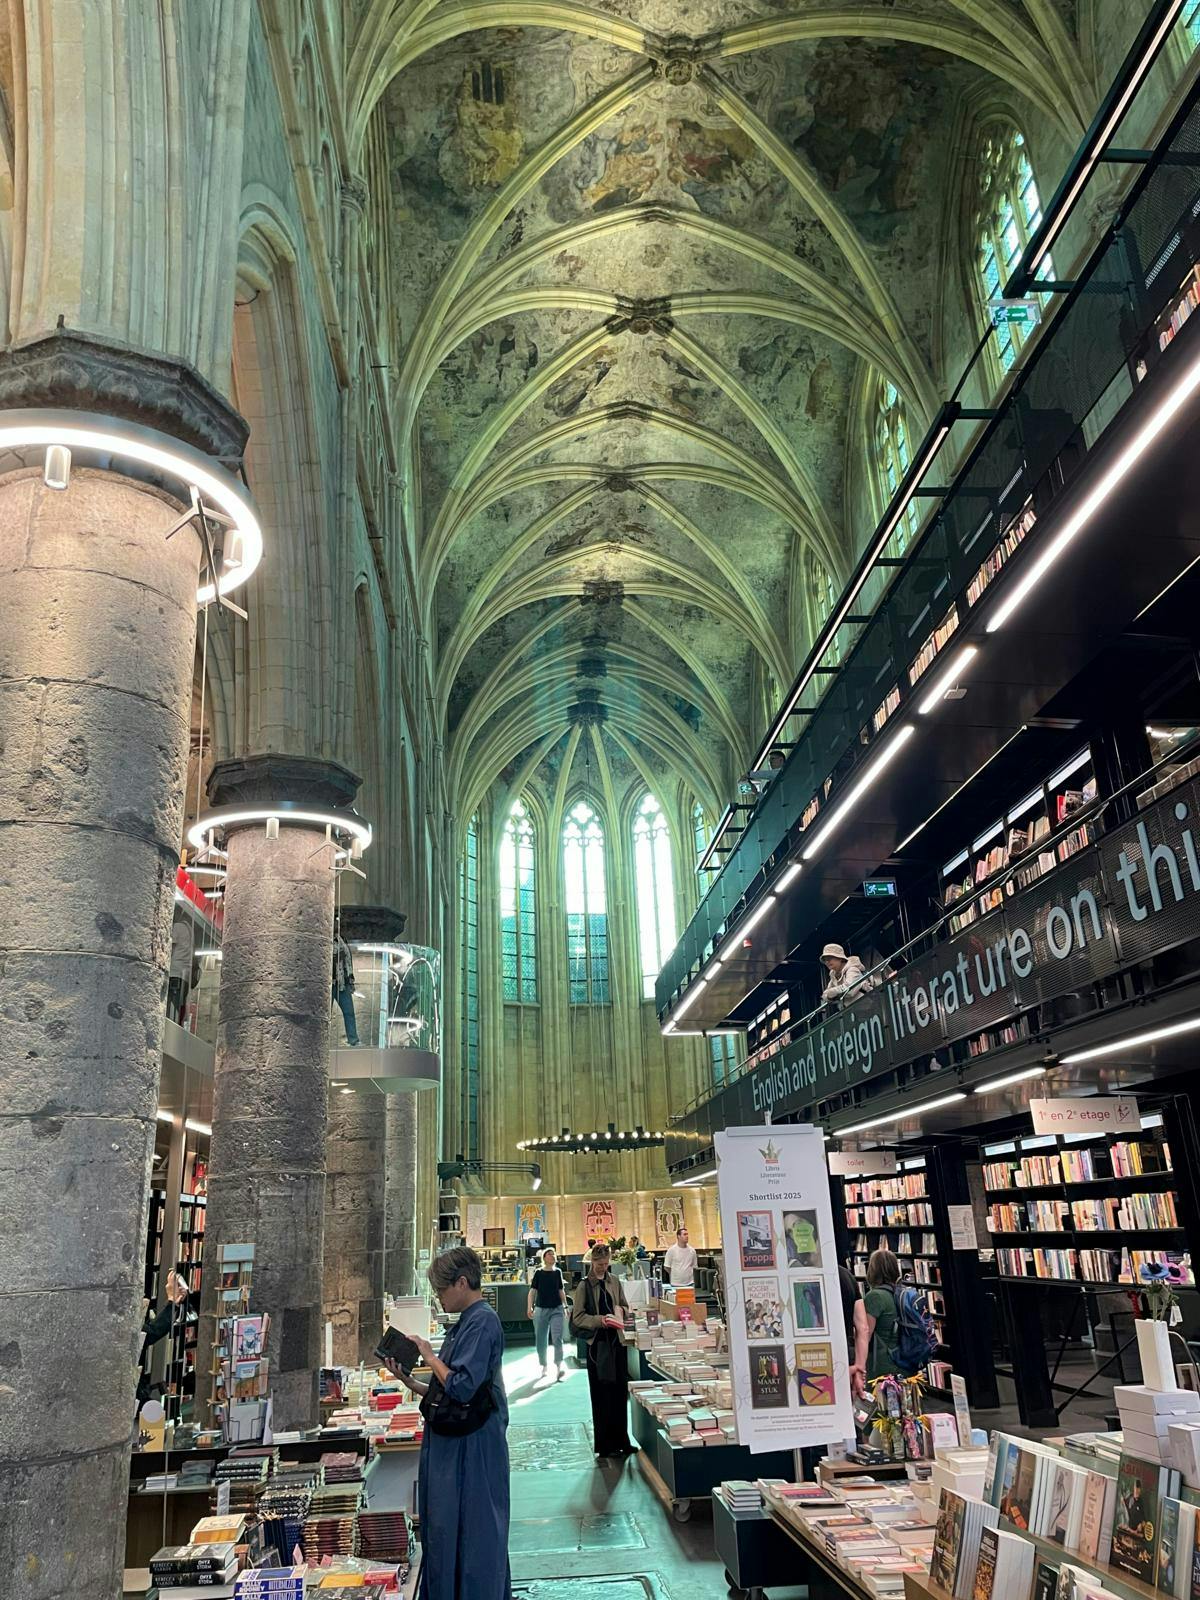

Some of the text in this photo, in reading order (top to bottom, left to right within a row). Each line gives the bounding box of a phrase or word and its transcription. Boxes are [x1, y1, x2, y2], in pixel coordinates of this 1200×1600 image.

[751, 1054, 792, 1116] English
[791, 1036, 817, 1091] and
[820, 1013, 884, 1077] foreign
[887, 928, 1033, 1041] literature
[1045, 889, 1103, 960] on
[1050, 1111, 1064, 1121] en
[1079, 1110, 1110, 1122] etage
[847, 1158, 865, 1166] toilet
[749, 1191, 802, 1201] Shortlist 2025
